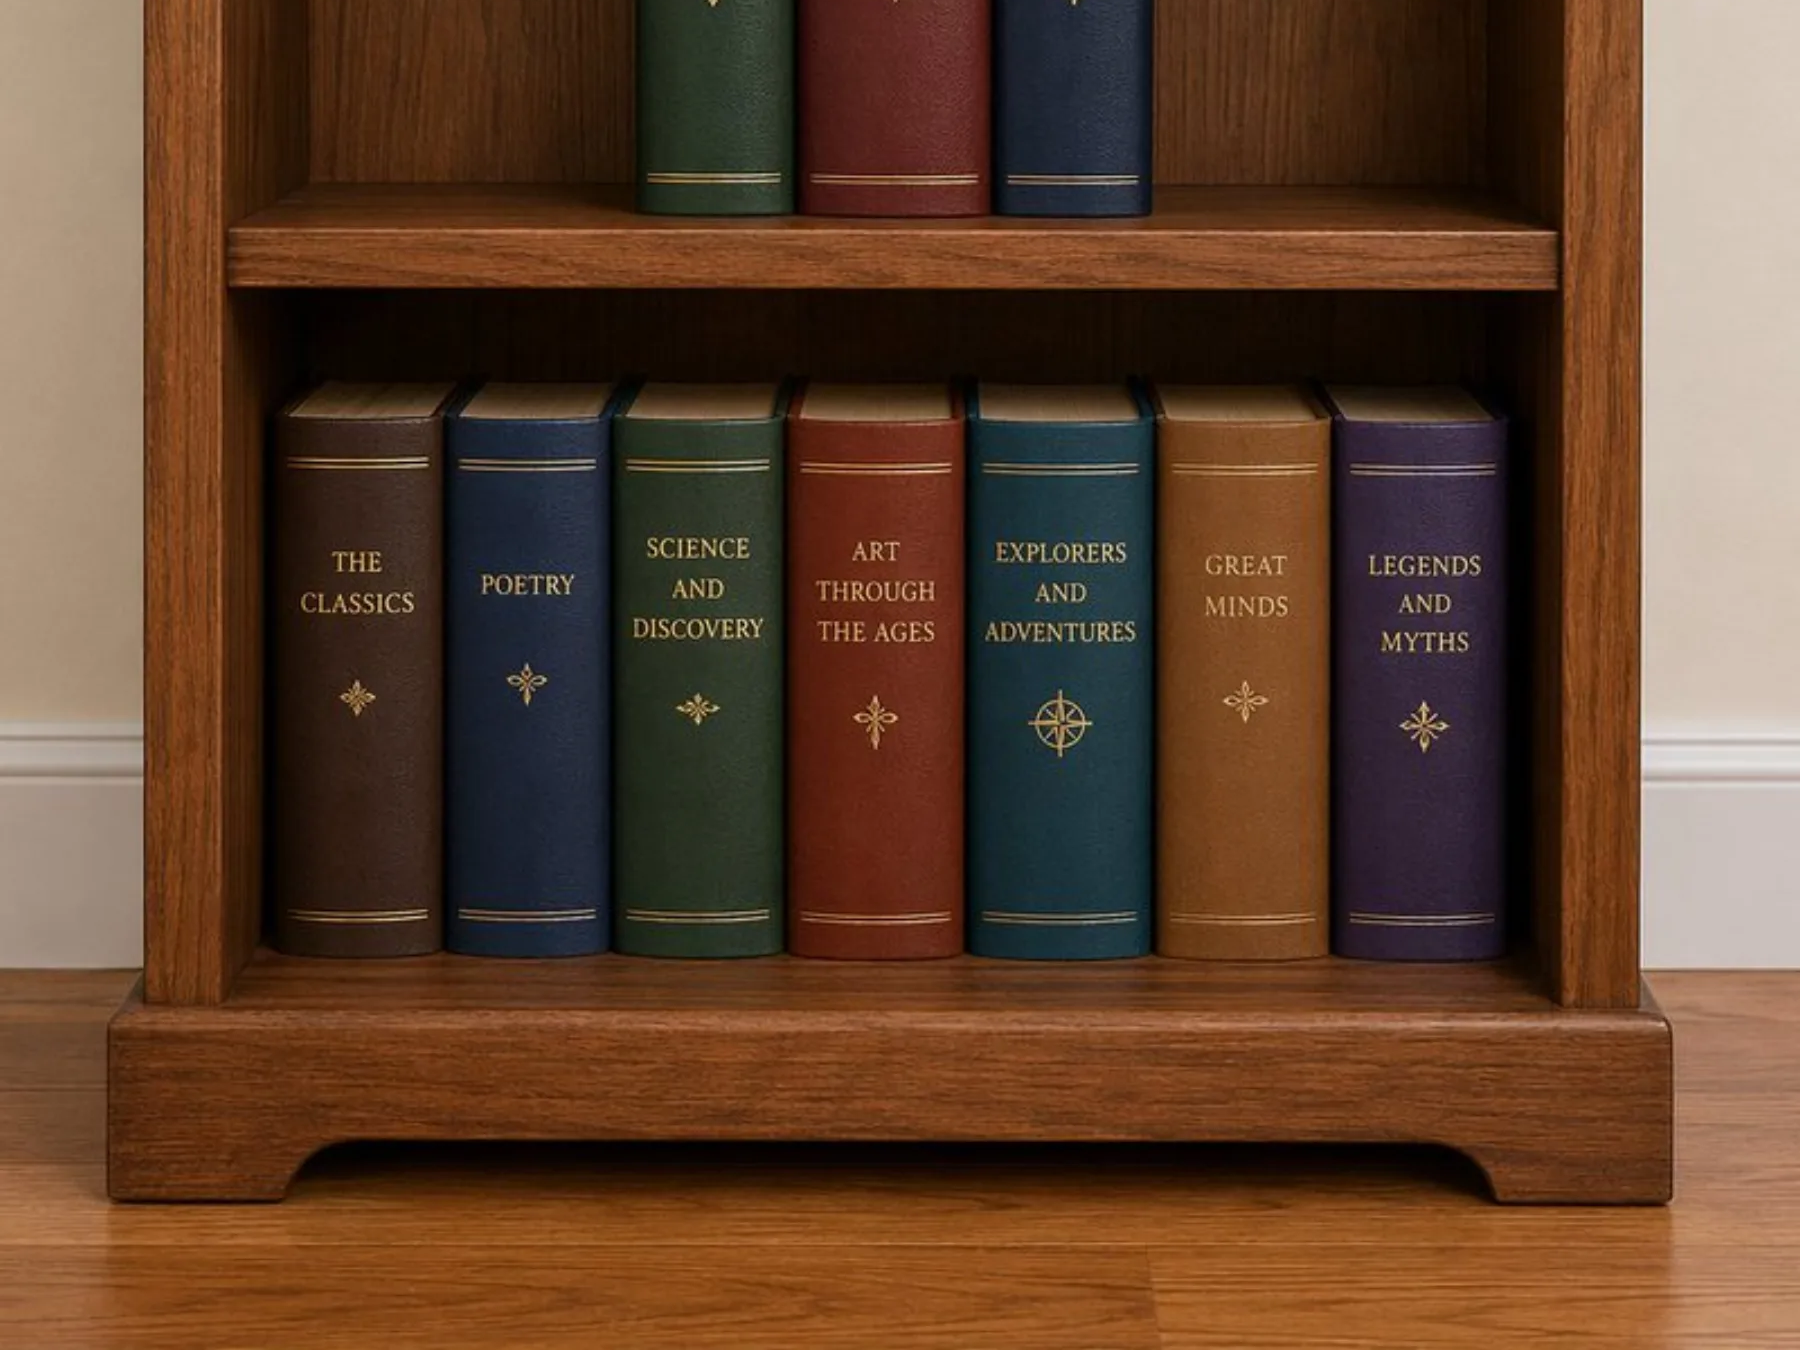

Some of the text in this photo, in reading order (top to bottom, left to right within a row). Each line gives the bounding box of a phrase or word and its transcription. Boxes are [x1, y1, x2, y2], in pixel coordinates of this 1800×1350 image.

[647, 537, 751, 559] SCIENCE
[851, 541, 901, 562] ART
[996, 542, 1127, 564] EXPLORERS
[331, 550, 383, 573] THE
[1205, 554, 1288, 576] GREAT
[1369, 554, 1482, 577] LEGENDS
[481, 573, 575, 596] POETRY
[671, 577, 725, 600] AND
[815, 580, 935, 602] THROUGH
[1035, 582, 1088, 603] AND
[300, 591, 415, 615] CLASSICS
[1205, 595, 1289, 618] MINDS
[1398, 593, 1452, 614] AND
[633, 617, 764, 640] DISCOVERY
[817, 620, 935, 643] THE AGES
[985, 620, 1137, 643] ADVENTURES
[1380, 631, 1470, 654] MYTHS
